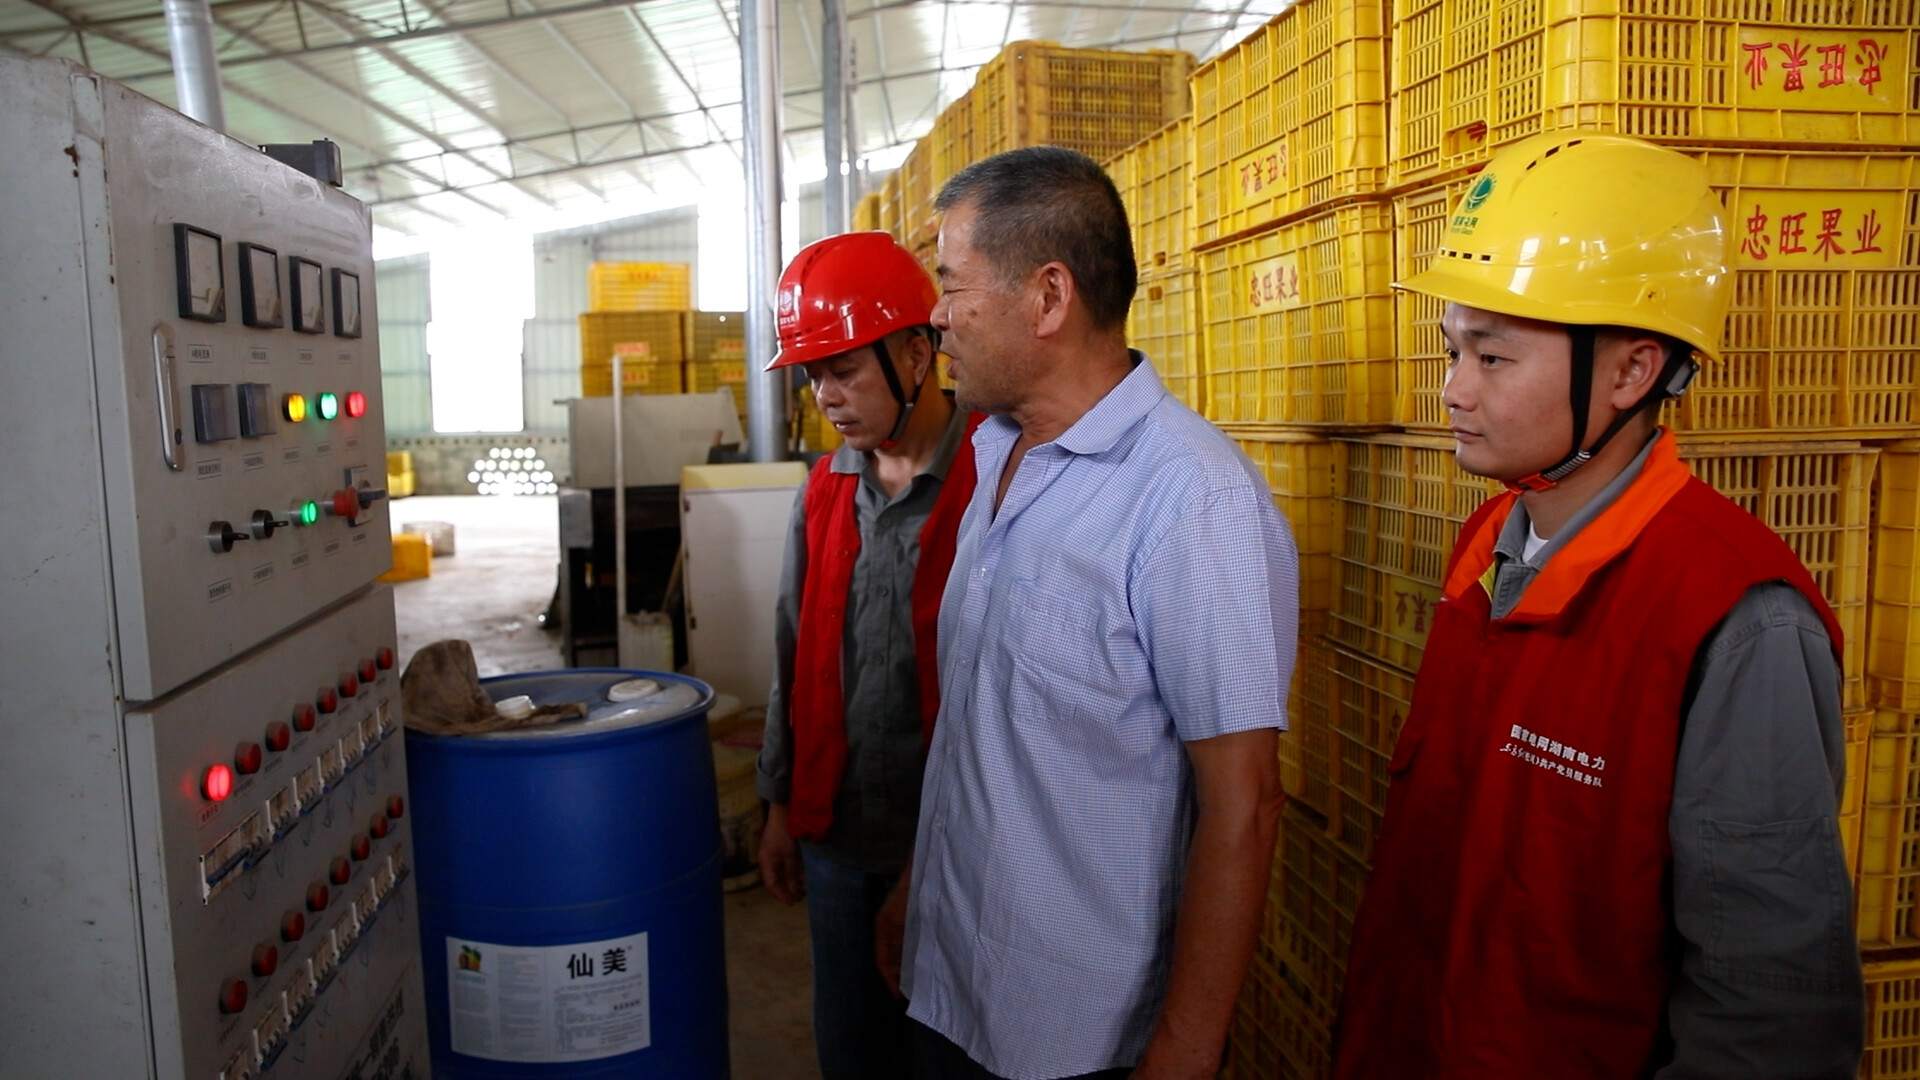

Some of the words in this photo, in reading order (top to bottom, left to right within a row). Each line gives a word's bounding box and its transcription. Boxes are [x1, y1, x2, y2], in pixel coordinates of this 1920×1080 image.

[1741, 38, 1889, 96] 忠旺果业
[1740, 204, 1883, 263] 忠旺果业
[1250, 264, 1299, 308] 忠旺果业
[1394, 590, 1438, 634] 果业
[1510, 724, 1606, 771] 国家电网湖南电力
[566, 947, 628, 980] 仙美
